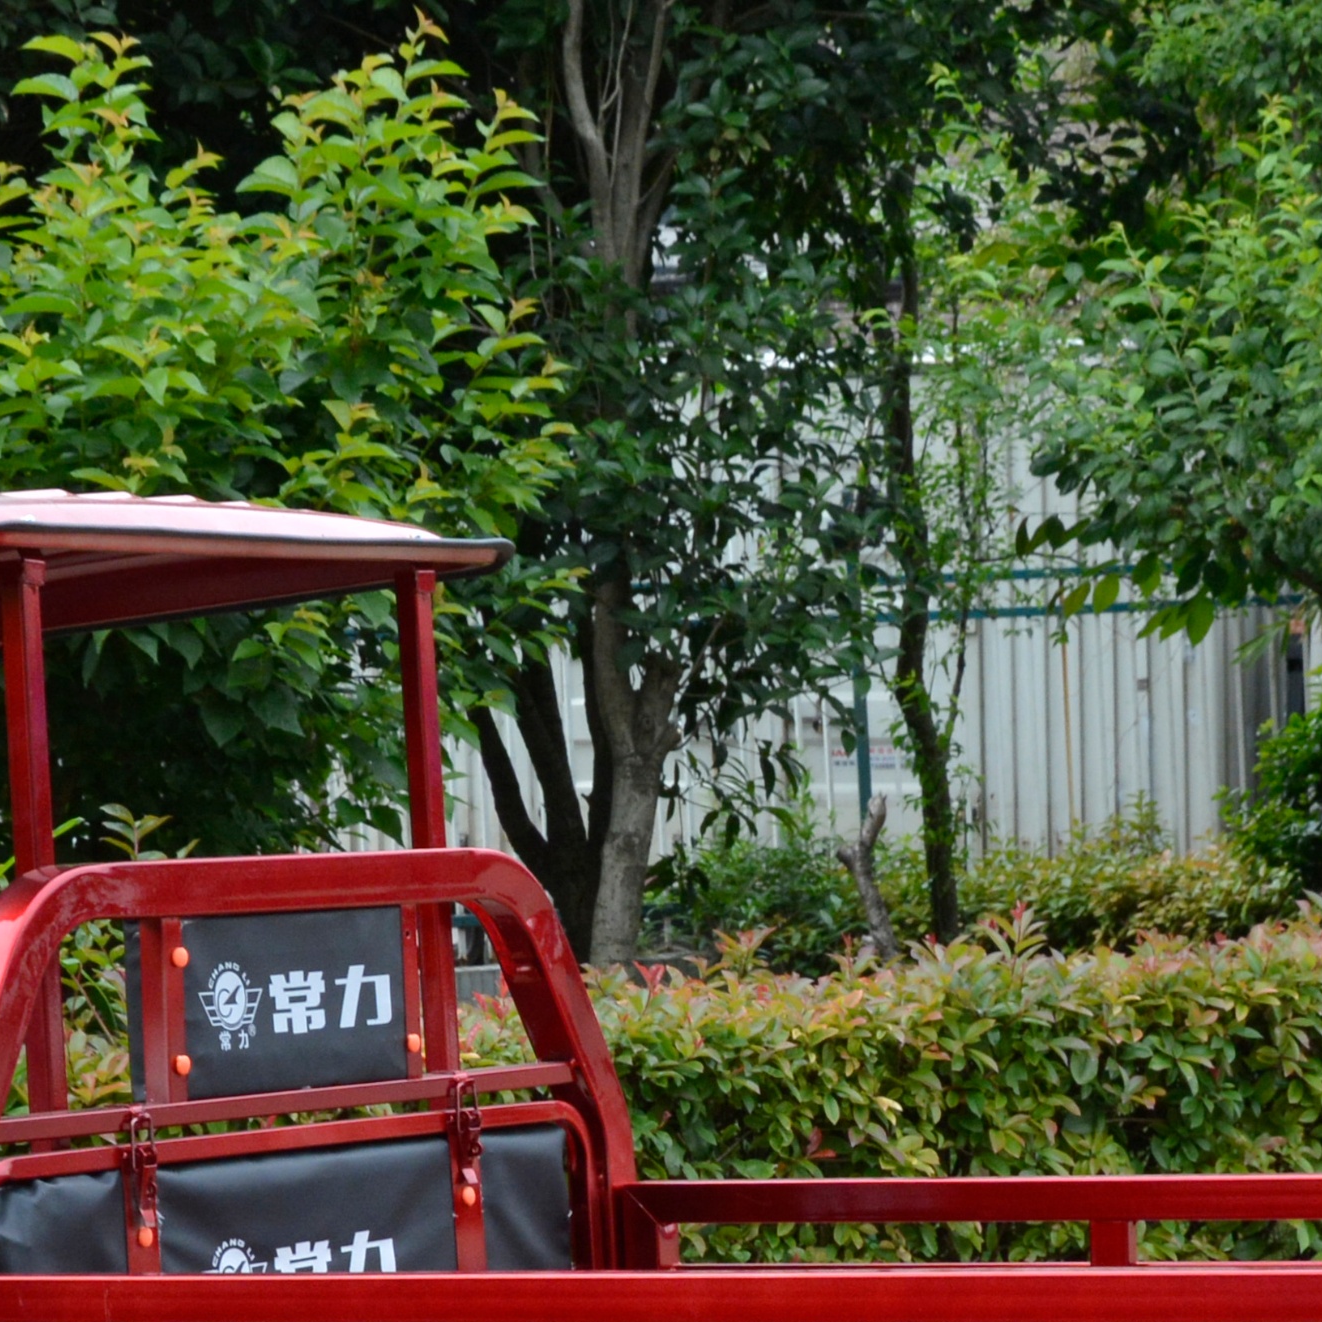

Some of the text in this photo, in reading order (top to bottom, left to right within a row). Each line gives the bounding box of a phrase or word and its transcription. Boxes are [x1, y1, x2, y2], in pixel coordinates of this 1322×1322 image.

[208, 961, 241, 989] CHANG
[268, 964, 393, 1034] 常力
[211, 1238, 245, 1268] CHANG
